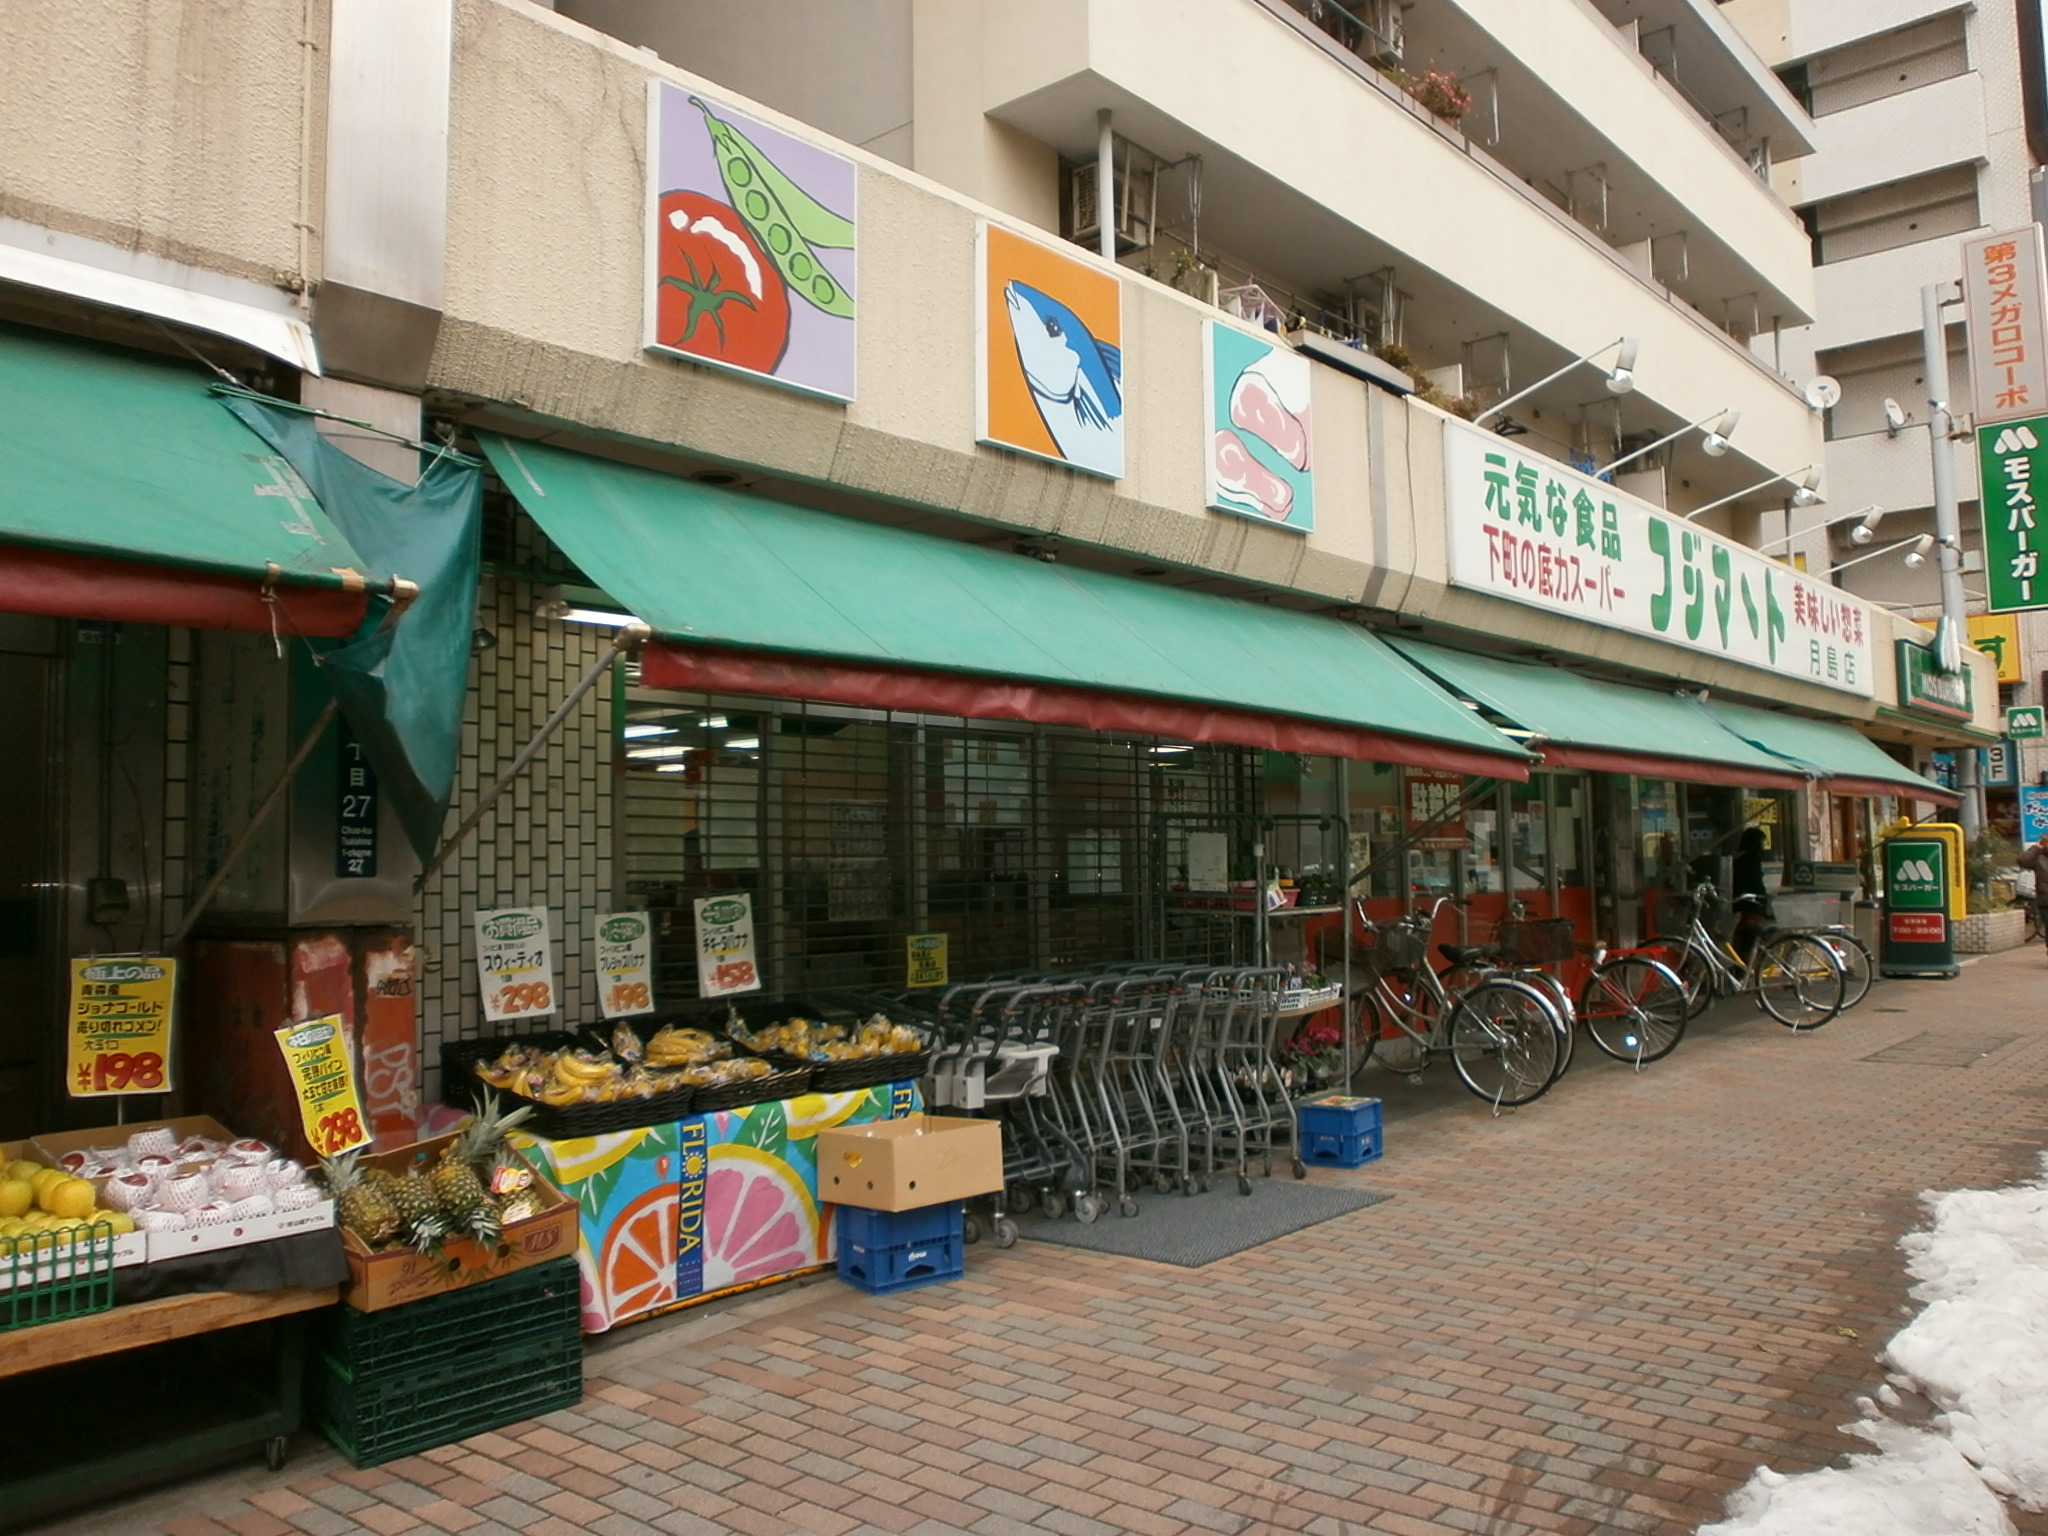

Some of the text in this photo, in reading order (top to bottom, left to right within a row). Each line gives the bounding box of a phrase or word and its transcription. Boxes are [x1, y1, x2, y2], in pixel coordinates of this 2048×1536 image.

[1984, 240, 2029, 409] 第3メガロコーポ
[1484, 452, 1622, 562] 元気な食品
[2004, 456, 2039, 601] モスバーガー
[1482, 523, 1626, 612] 下町の底力スーパー
[1793, 581, 1864, 647] 美味しい惣菜
[1810, 638, 1856, 685] 月島店
[342, 794, 371, 818] 27
